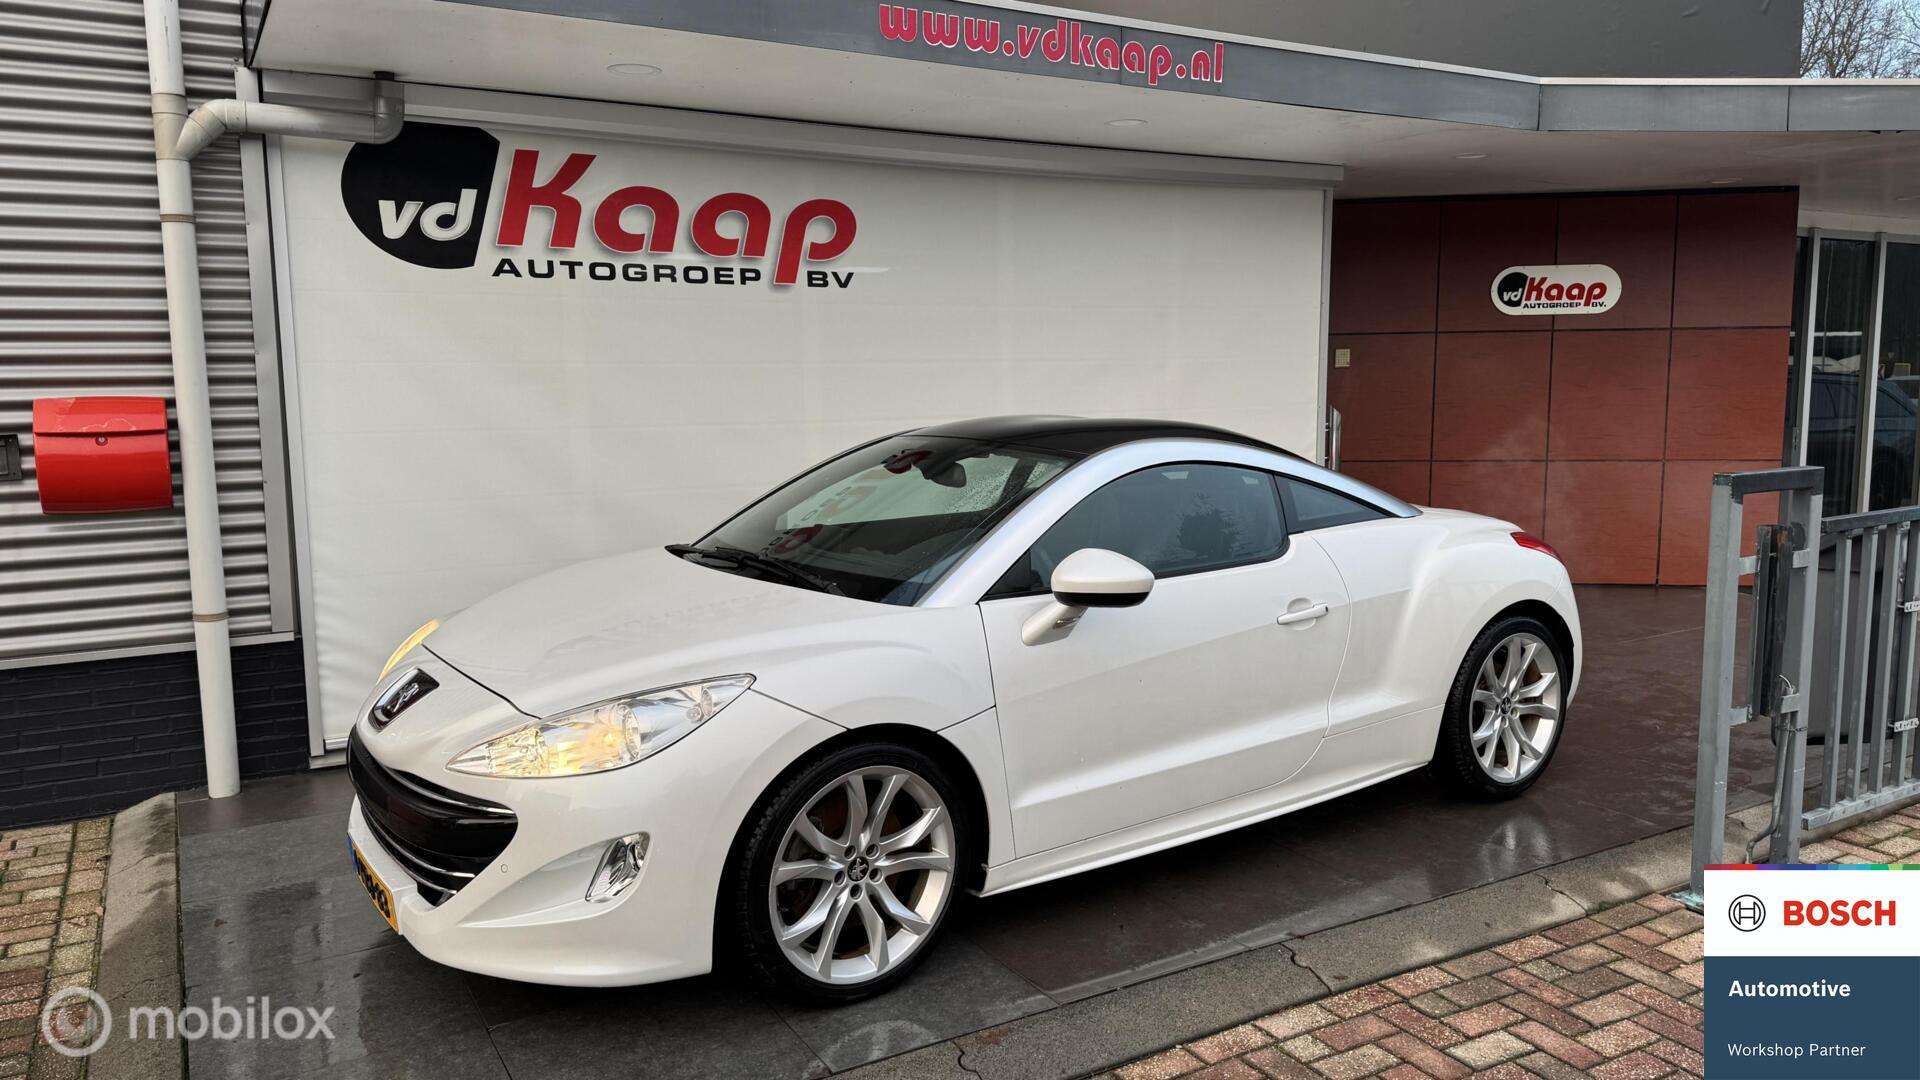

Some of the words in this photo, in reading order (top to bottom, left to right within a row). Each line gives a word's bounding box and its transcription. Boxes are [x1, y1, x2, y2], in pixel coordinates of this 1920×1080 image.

[879, 3, 1224, 86] www.vdkaap.nl
[377, 188, 478, 242] vd
[495, 149, 858, 286] Kaap
[492, 257, 763, 286] AUTOGROEP
[806, 270, 855, 289] BV
[1503, 287, 1523, 302] vd
[1524, 276, 1608, 307] Kaap
[1522, 301, 1582, 309] AUTOGROEP
